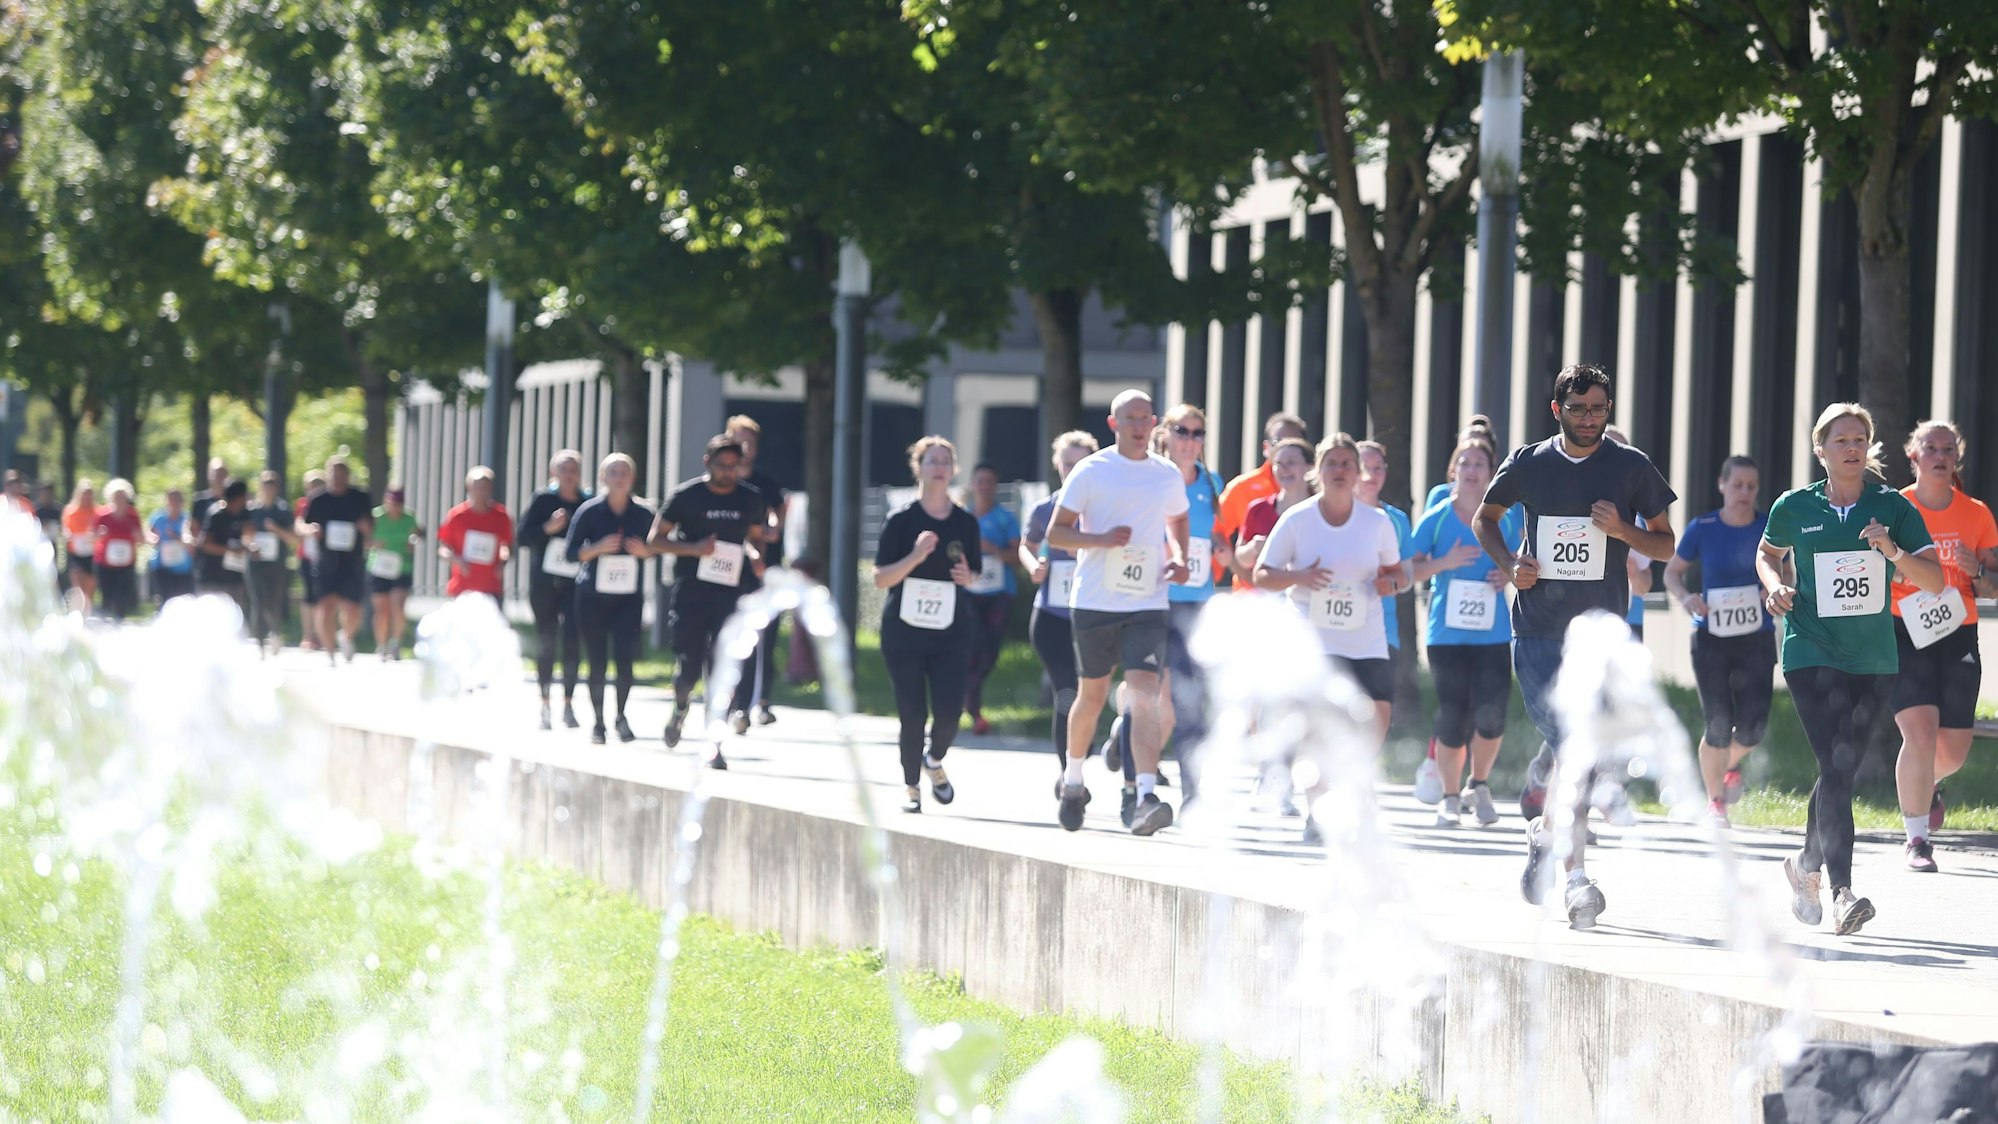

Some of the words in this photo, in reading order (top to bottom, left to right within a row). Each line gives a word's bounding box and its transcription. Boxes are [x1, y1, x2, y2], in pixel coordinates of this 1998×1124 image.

[1801, 524, 1823, 534] hummel
[1553, 542, 1590, 563] 205
[1123, 564, 1143, 581] 40
[1557, 568, 1586, 576] Nagaraj
[1833, 577, 1870, 599] 295
[916, 599, 942, 615] 127
[1325, 599, 1353, 617] 105
[1459, 599, 1486, 617] 223
[1713, 605, 1758, 627] 1703
[1841, 603, 1864, 611] Sarah
[1920, 604, 1952, 629] 338
